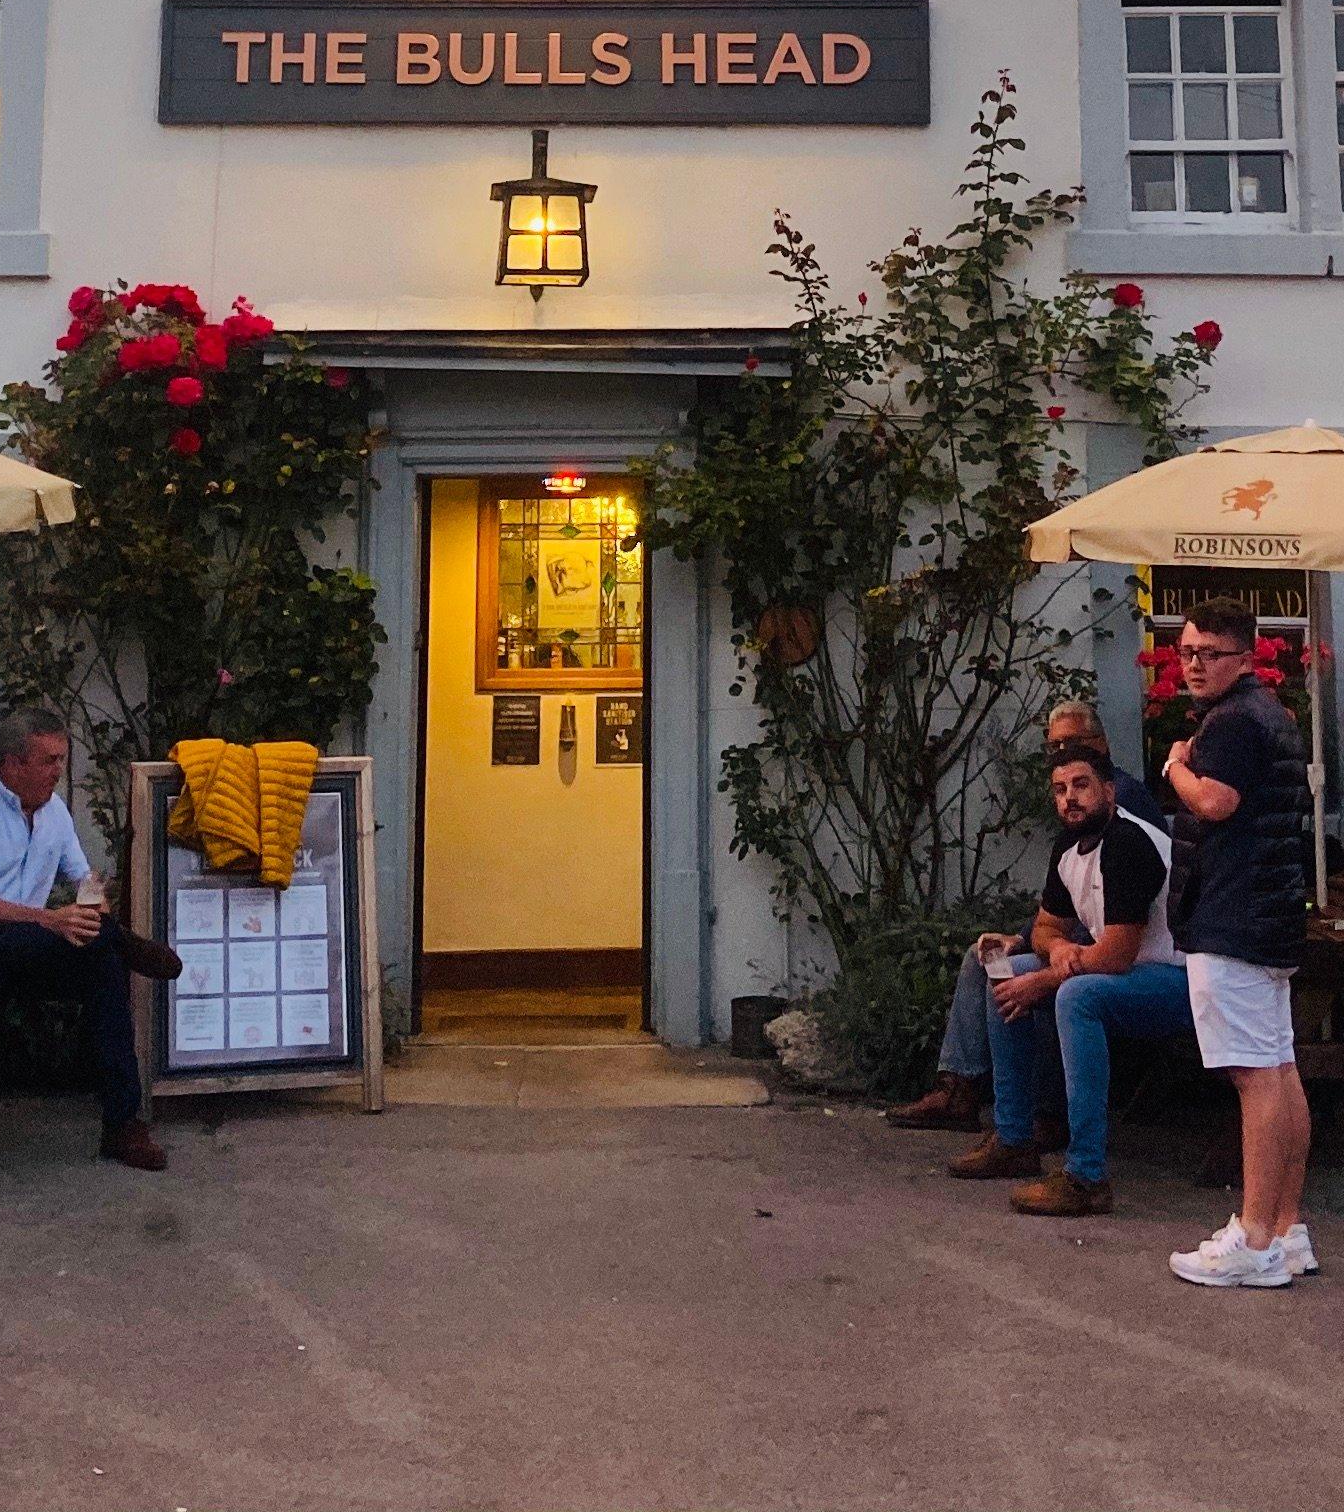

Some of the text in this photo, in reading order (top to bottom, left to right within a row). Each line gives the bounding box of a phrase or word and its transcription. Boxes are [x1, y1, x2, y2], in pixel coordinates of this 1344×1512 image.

[222, 31, 872, 86] THE BULLS HEAD
[1173, 537, 1302, 557] ROBINSONS
